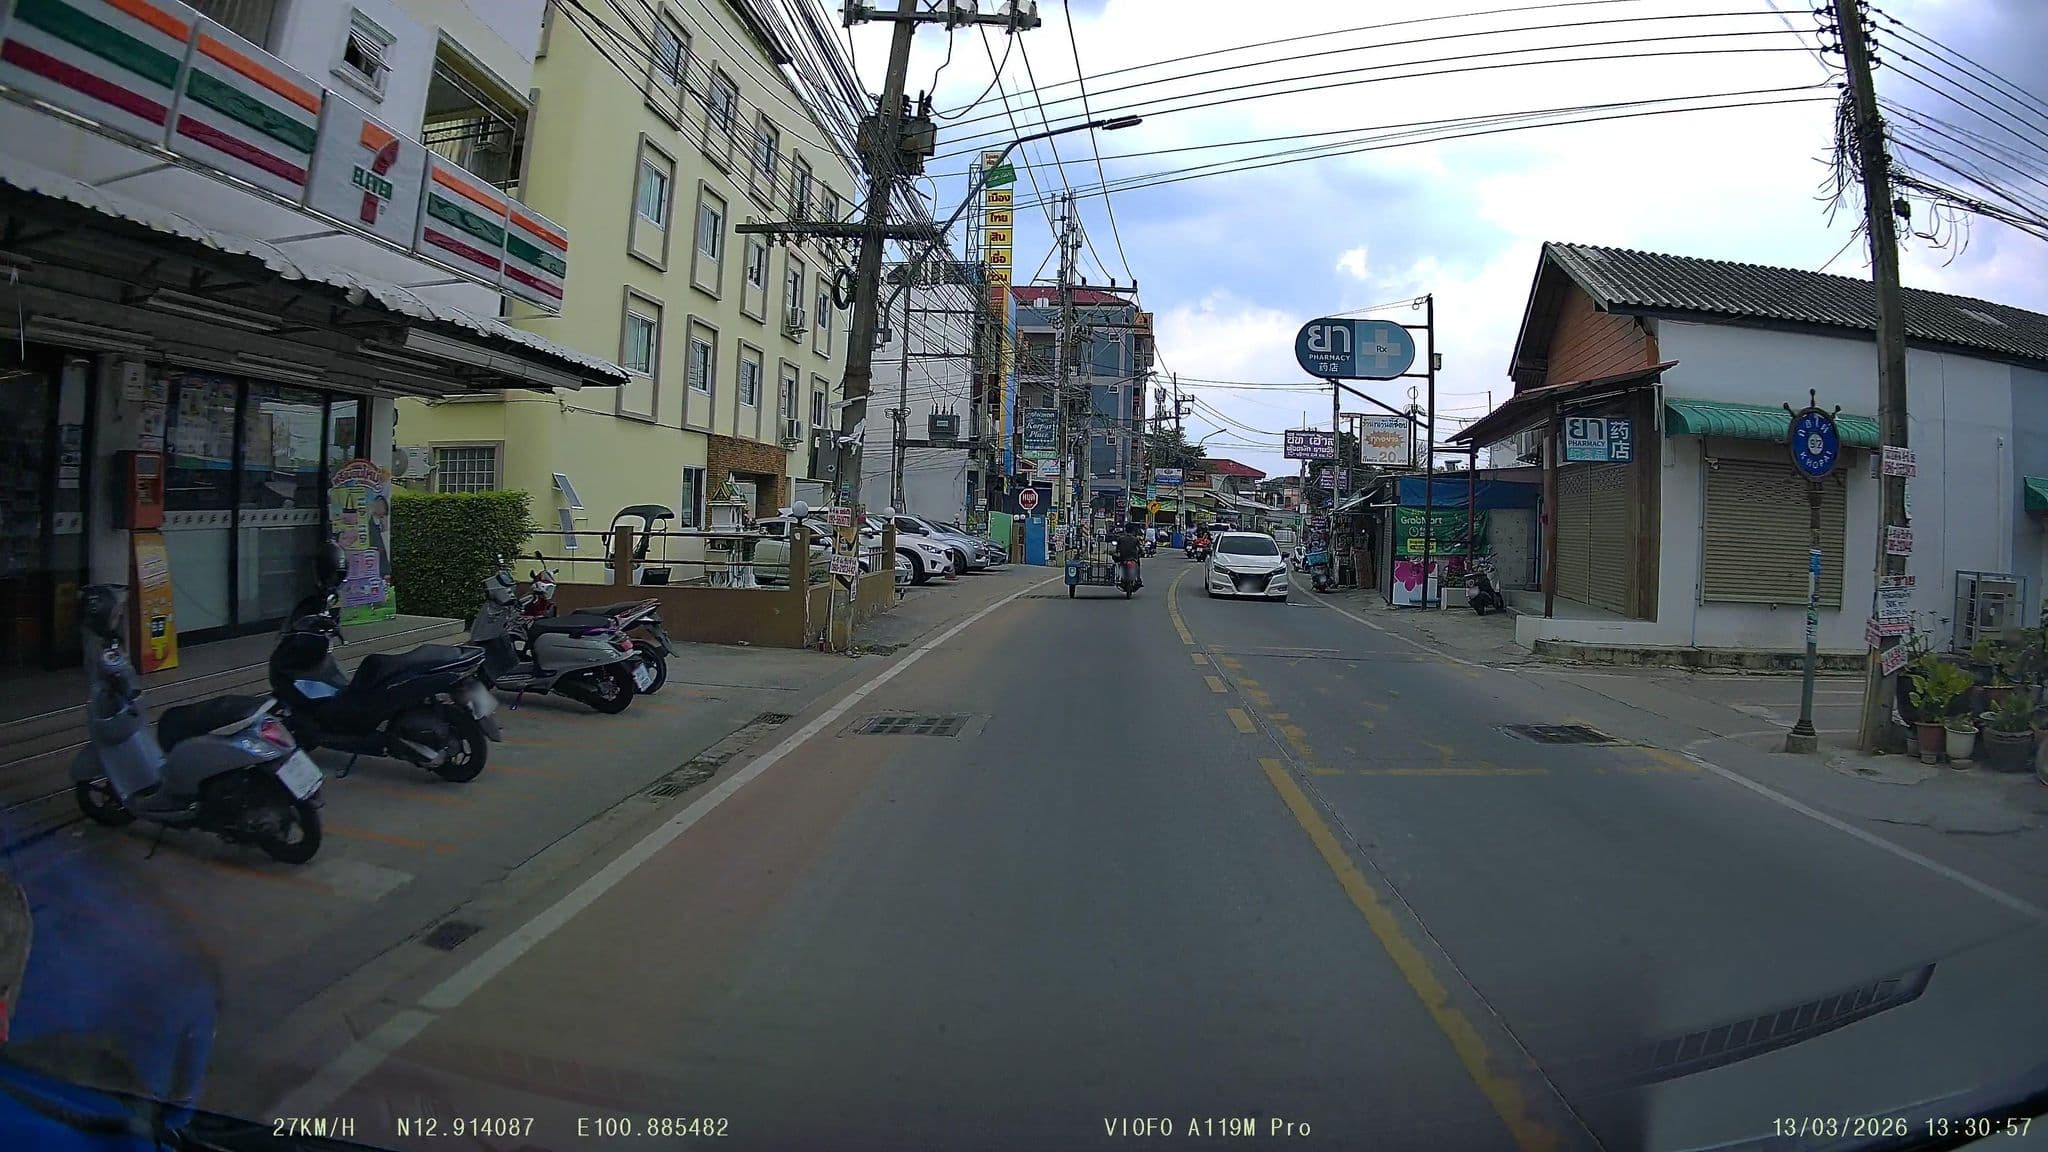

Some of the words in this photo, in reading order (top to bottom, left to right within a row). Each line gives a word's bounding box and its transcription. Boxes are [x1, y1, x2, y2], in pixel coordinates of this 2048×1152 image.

[988, 192, 1011, 202] เมือง
[990, 212, 1008, 222] ไทย
[990, 232, 1006, 242] สิน
[1307, 325, 1351, 353] ยา
[1376, 345, 1388, 353] Rx
[1319, 362, 1339, 372] 药店
[1569, 419, 1604, 440] ยา
[1610, 421, 1630, 459] 药店
[1800, 451, 1832, 469] KHOPAI
